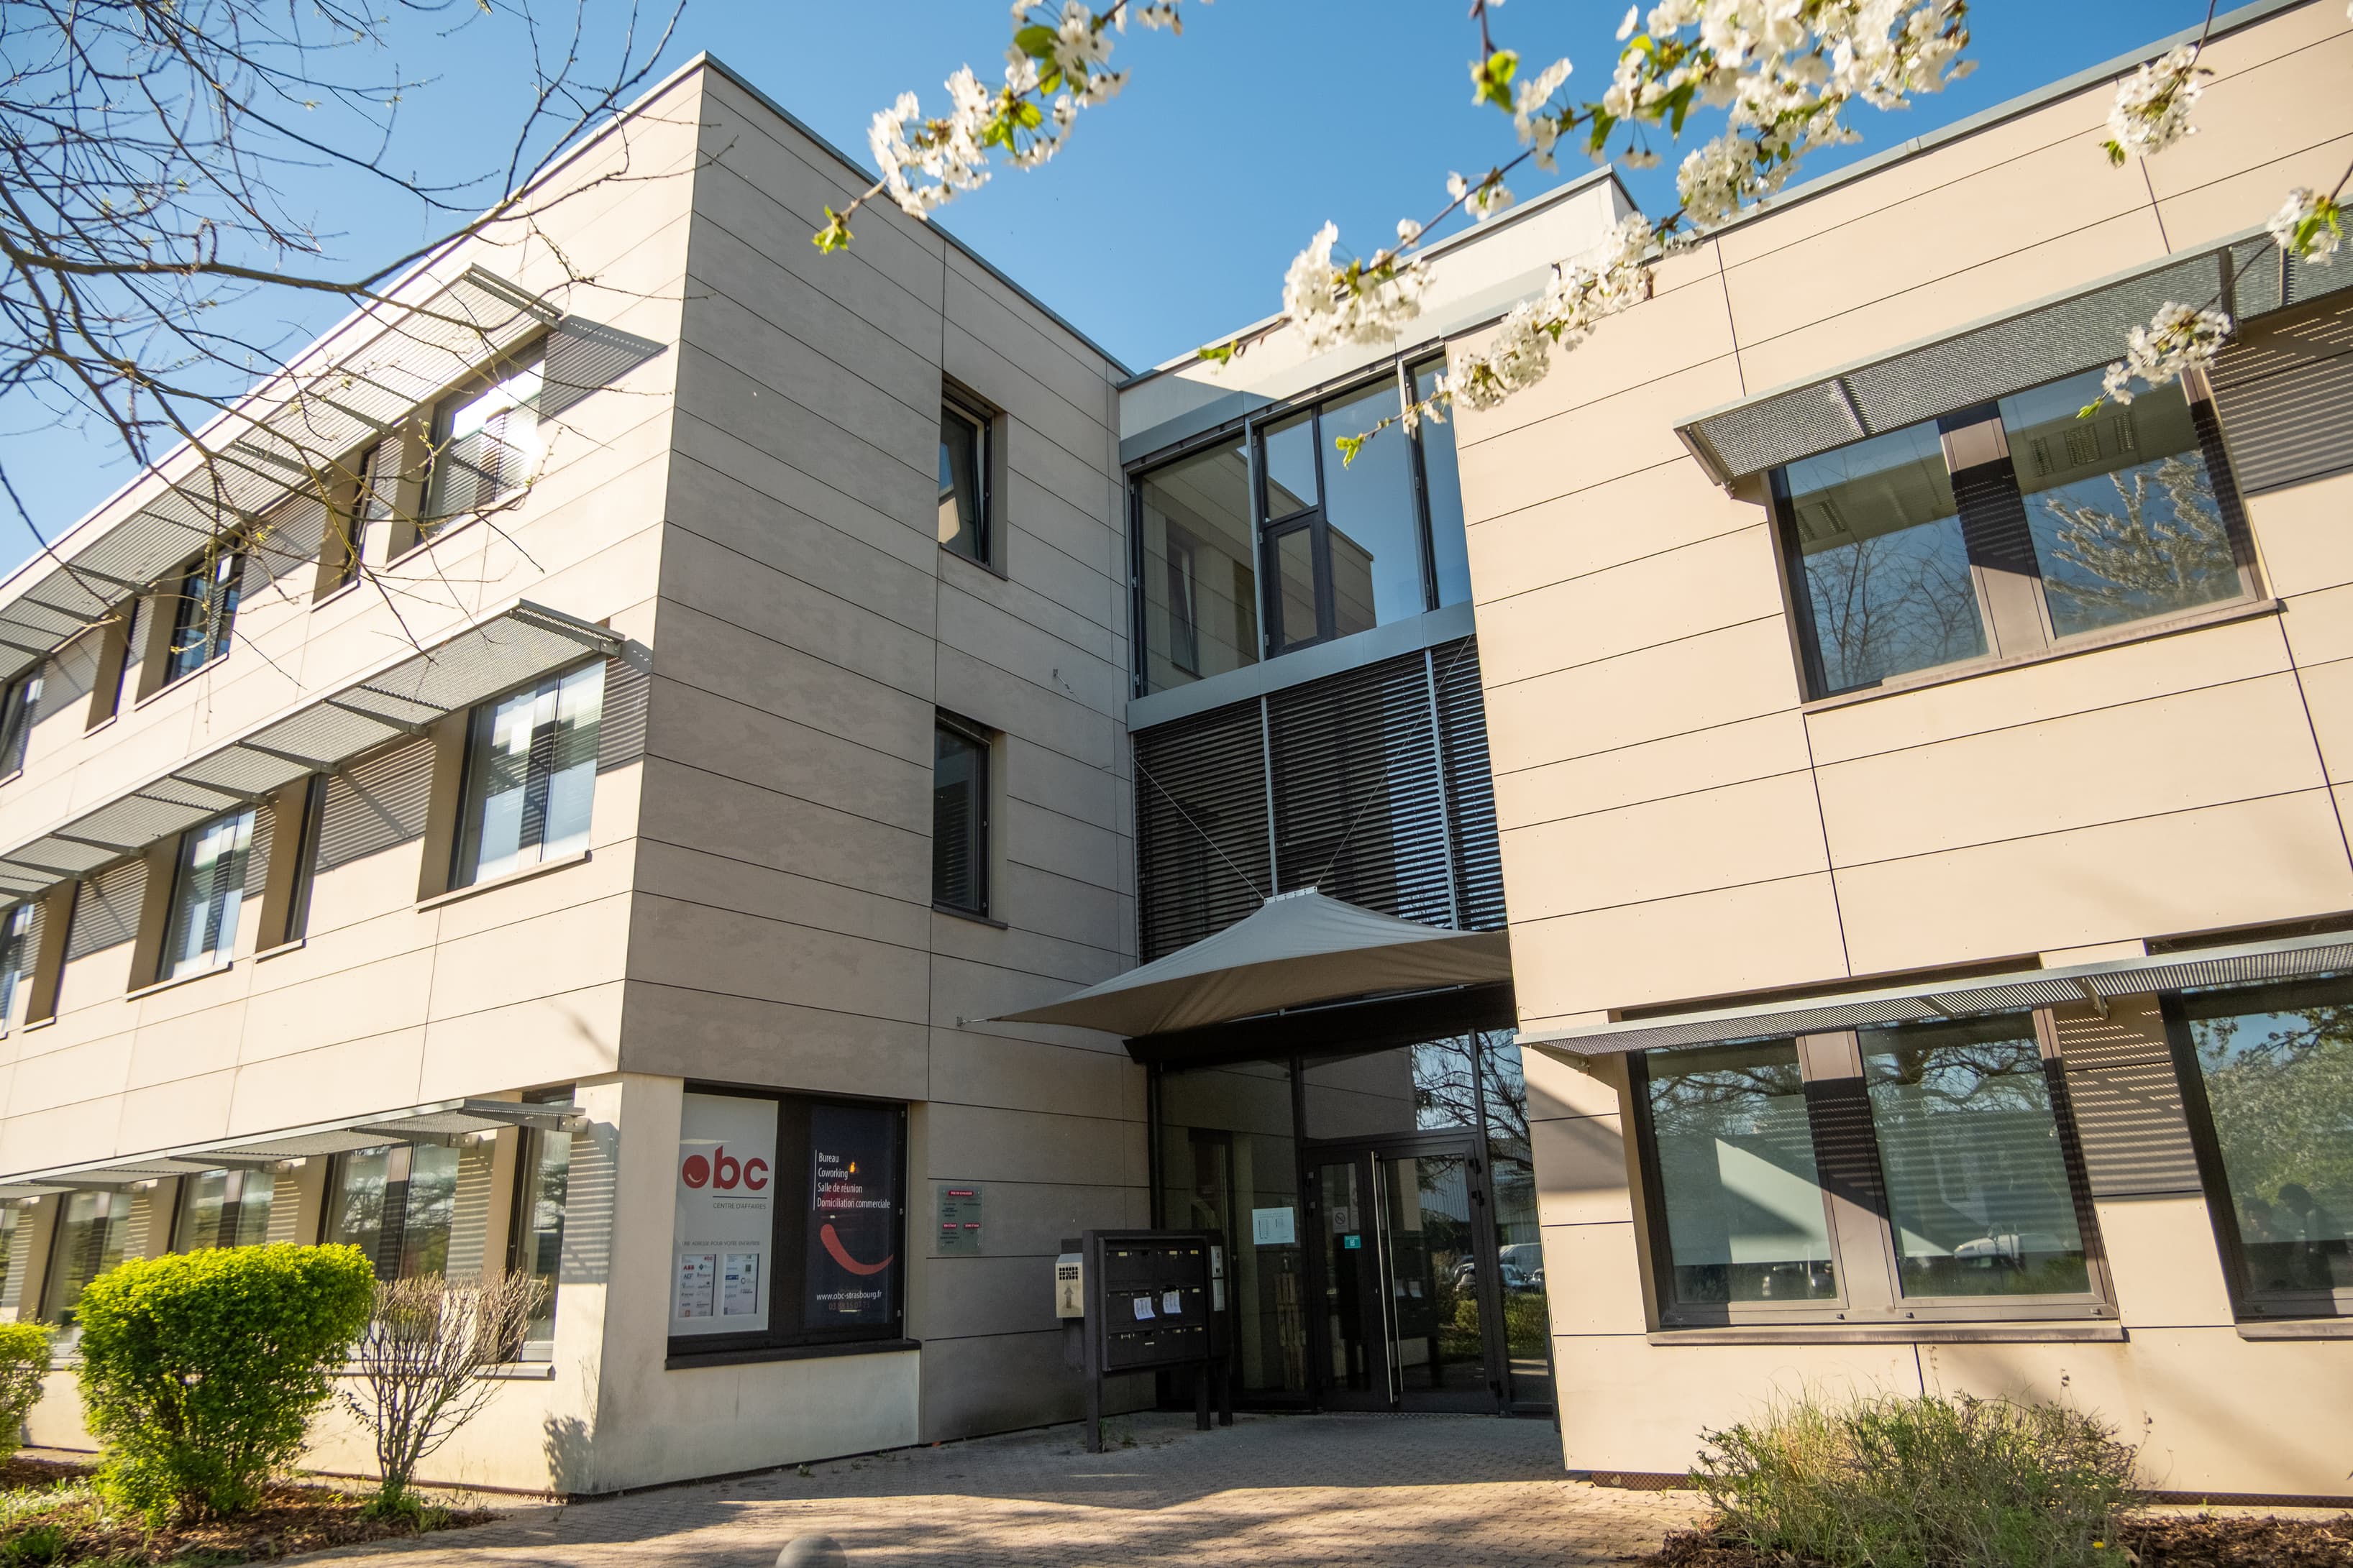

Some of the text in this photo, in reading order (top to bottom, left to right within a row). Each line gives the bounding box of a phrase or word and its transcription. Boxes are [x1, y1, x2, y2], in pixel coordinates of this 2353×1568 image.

[818, 1152, 839, 1163] Bureau
[682, 1145, 769, 1191] obc
[818, 1167, 849, 1180] Coworking
[817, 1182, 863, 1193] Salle de réunion
[817, 1197, 890, 1209] Domiciliation commerciale
[816, 1289, 882, 1301] www.obc-strasbourg.fr
